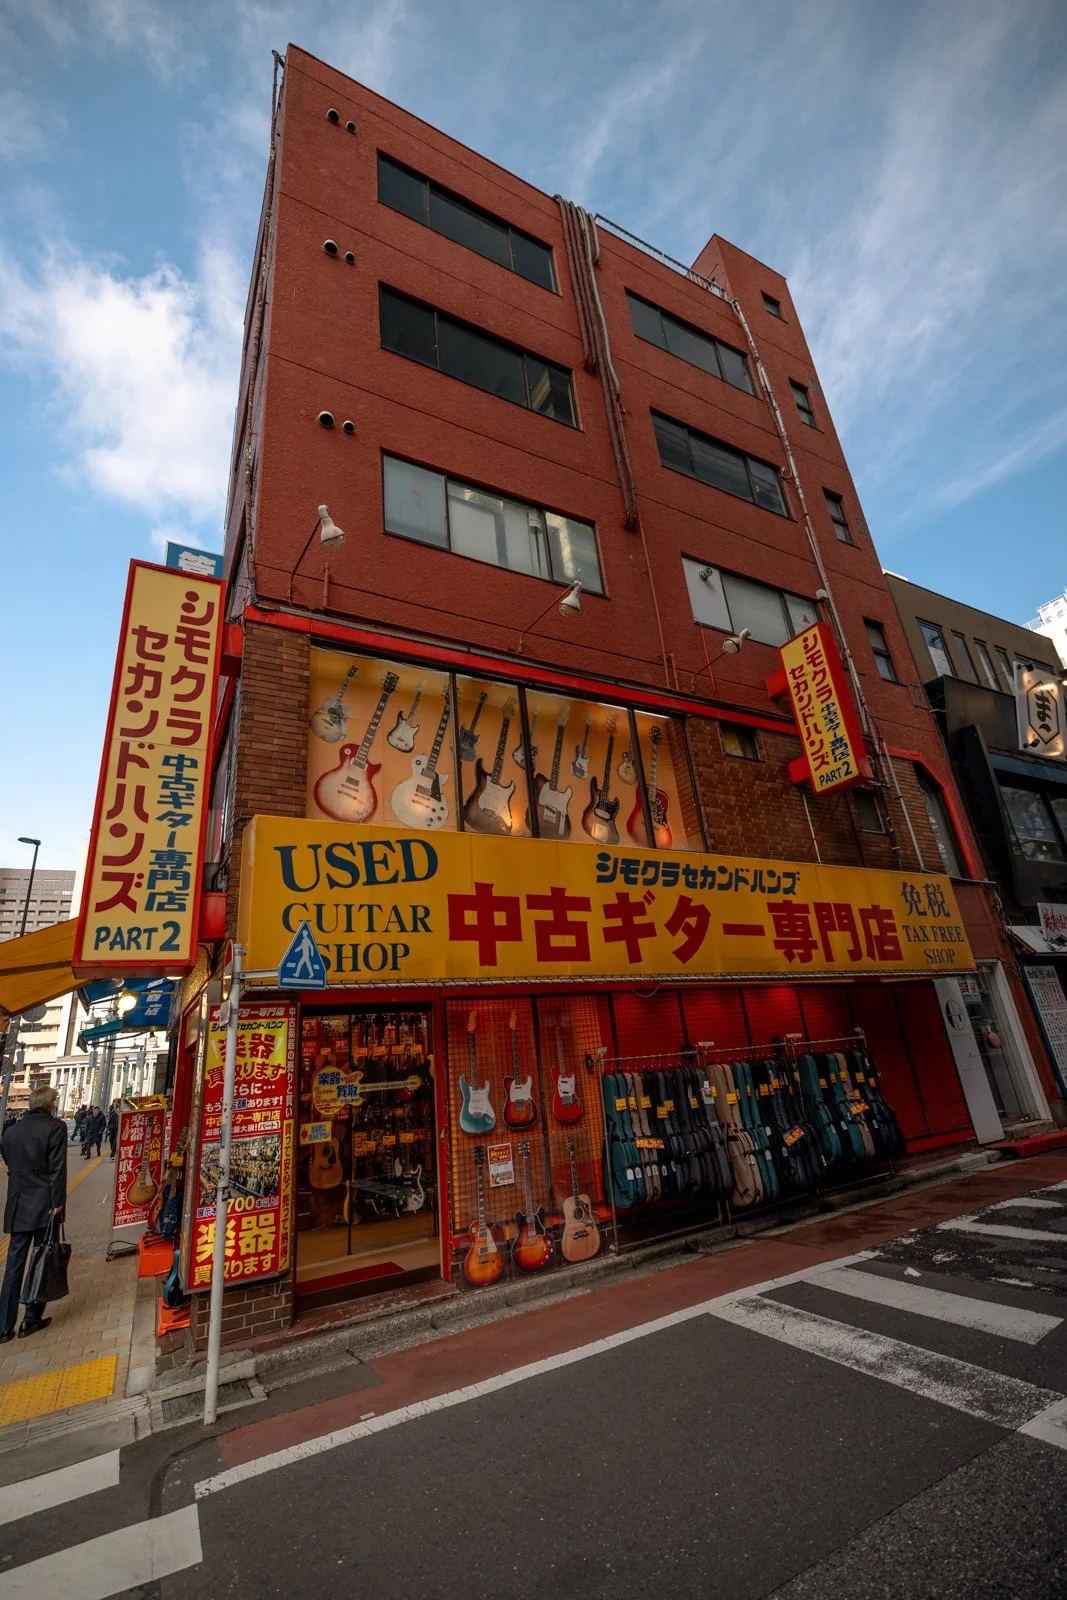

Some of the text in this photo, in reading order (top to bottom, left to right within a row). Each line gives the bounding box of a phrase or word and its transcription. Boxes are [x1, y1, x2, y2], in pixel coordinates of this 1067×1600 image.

[166, 591, 215, 747] シモクラ
[802, 632, 834, 705] シモクラ
[788, 664, 831, 772] セカンドハンズ
[821, 701, 850, 763] 中古ギター専門店
[94, 625, 169, 914] セカンドハンズ
[143, 753, 199, 913] 中古ギター専門店
[273, 838, 439, 893] USED
[595, 852, 801, 896] シモクラセカンドハンズ
[281, 902, 434, 934] GUITAR
[900, 880, 952, 919] 免税
[447, 881, 904, 967] 中古ギター専門店
[902, 925, 965, 944] TAX FREE
[316, 942, 411, 974] SHOP
[924, 948, 956, 965] SHOP
[211, 1021, 285, 1033] シモセカンドハンズ
[212, 1007, 286, 1021] 中ター専門店
[205, 1096, 284, 1112] もう店舗あります!
[129, 1113, 145, 1141] 楽器
[195, 1212, 276, 1264] 楽器
